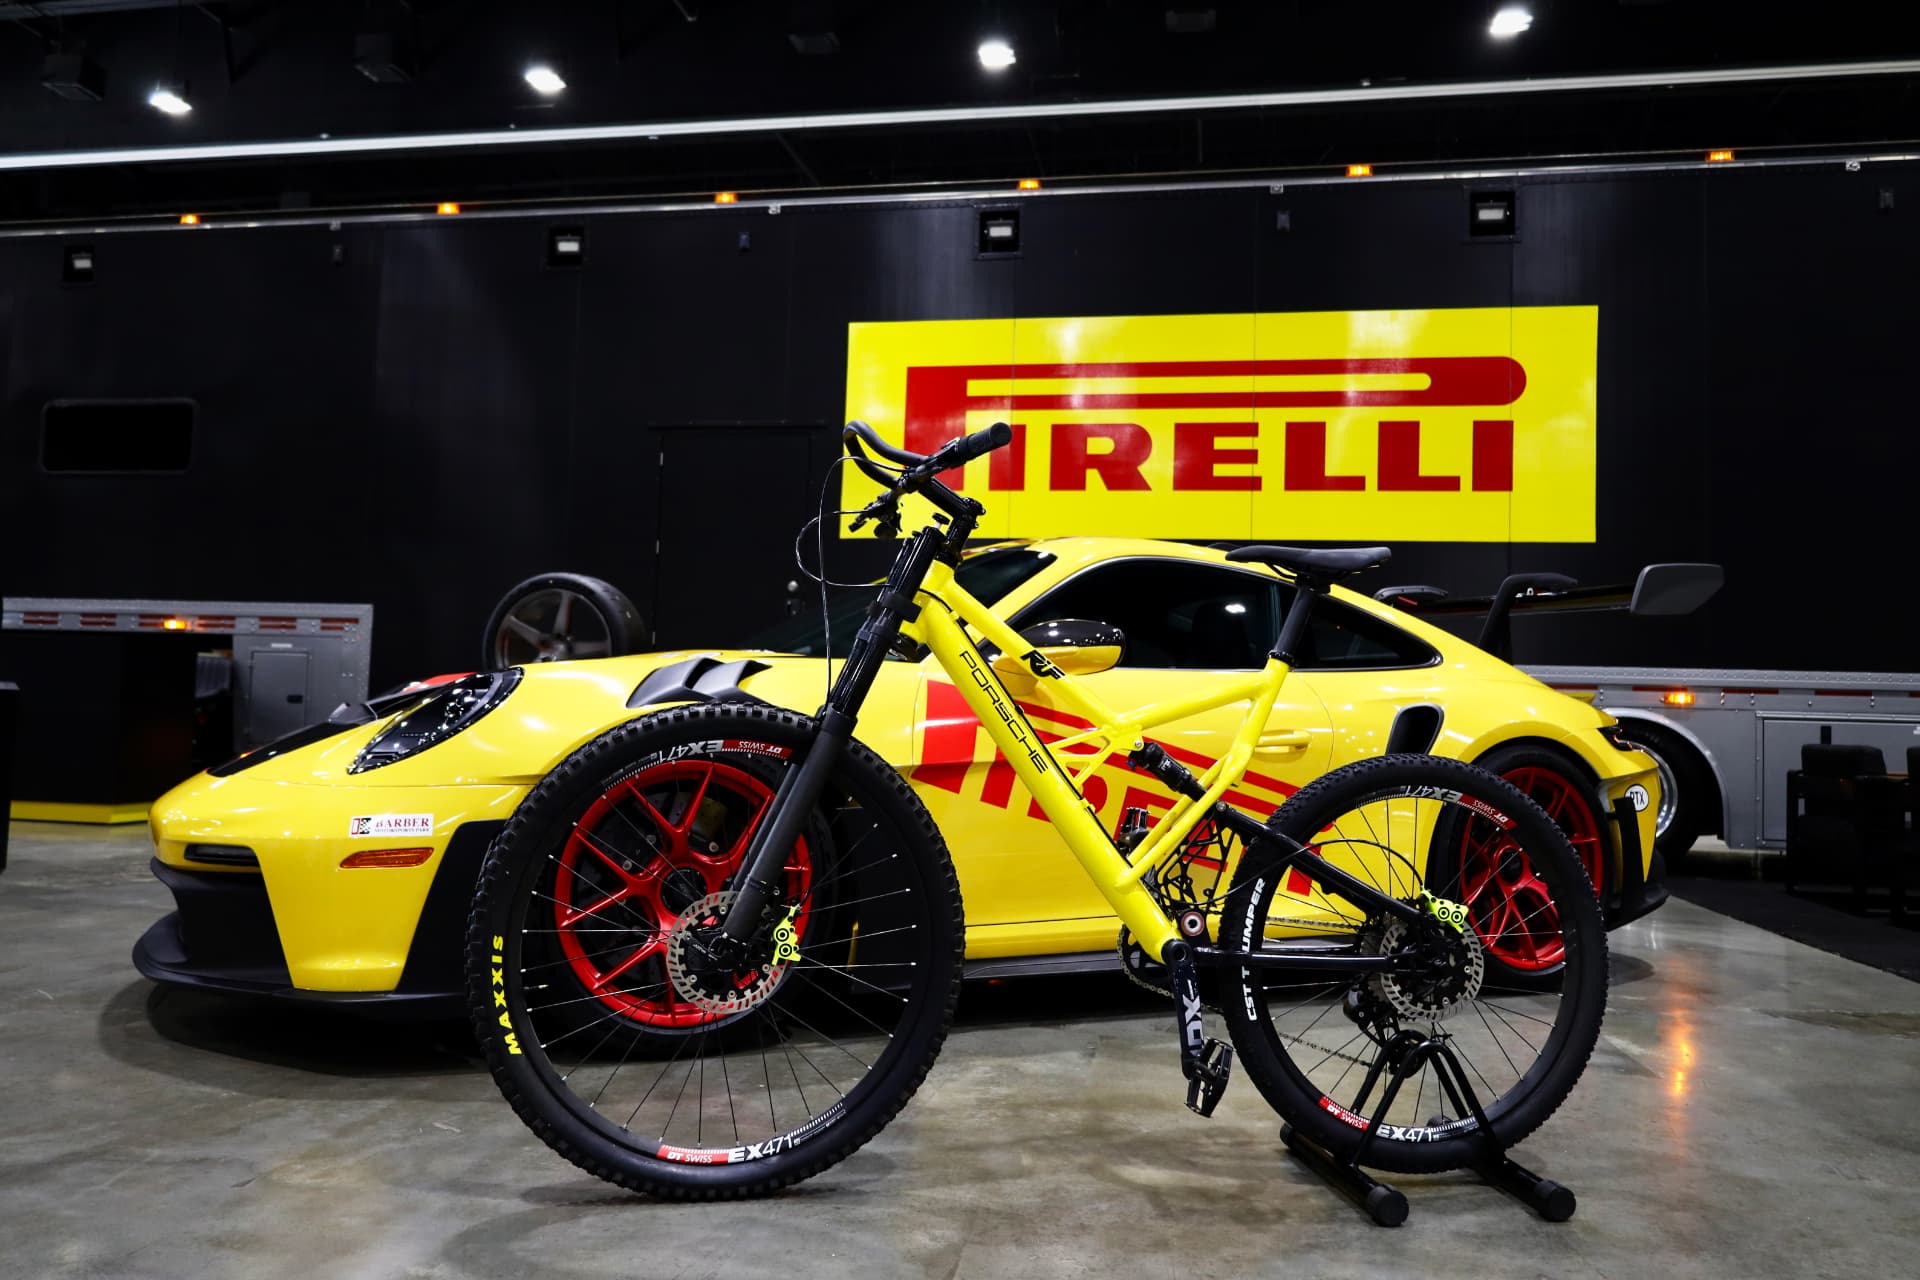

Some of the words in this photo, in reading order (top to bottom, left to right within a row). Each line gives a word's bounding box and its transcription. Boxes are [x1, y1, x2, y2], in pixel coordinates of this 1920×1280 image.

[905, 356, 1527, 492] PIRELLI
[960, 651, 1048, 774] PORSCHE
[658, 739, 724, 763] EX471
[738, 740, 766, 750] SWISS
[766, 745, 783, 754] DT
[911, 680, 1338, 897] PIELI
[1405, 785, 1463, 803] EX471
[1473, 799, 1495, 815] SWISS
[1494, 812, 1508, 823] DT
[376, 817, 430, 828] BARBER
[1241, 877, 1266, 979] TUMPER
[492, 935, 522, 1055] MAXXIS
[1243, 983, 1258, 1021] CST
[1327, 1104, 1340, 1116] DT
[1340, 1113, 1364, 1129] SWISS
[1376, 1124, 1432, 1142] EX471
[667, 1151, 684, 1160] DT
[684, 1153, 713, 1164] SWISS
[728, 1134, 793, 1164] EX471
